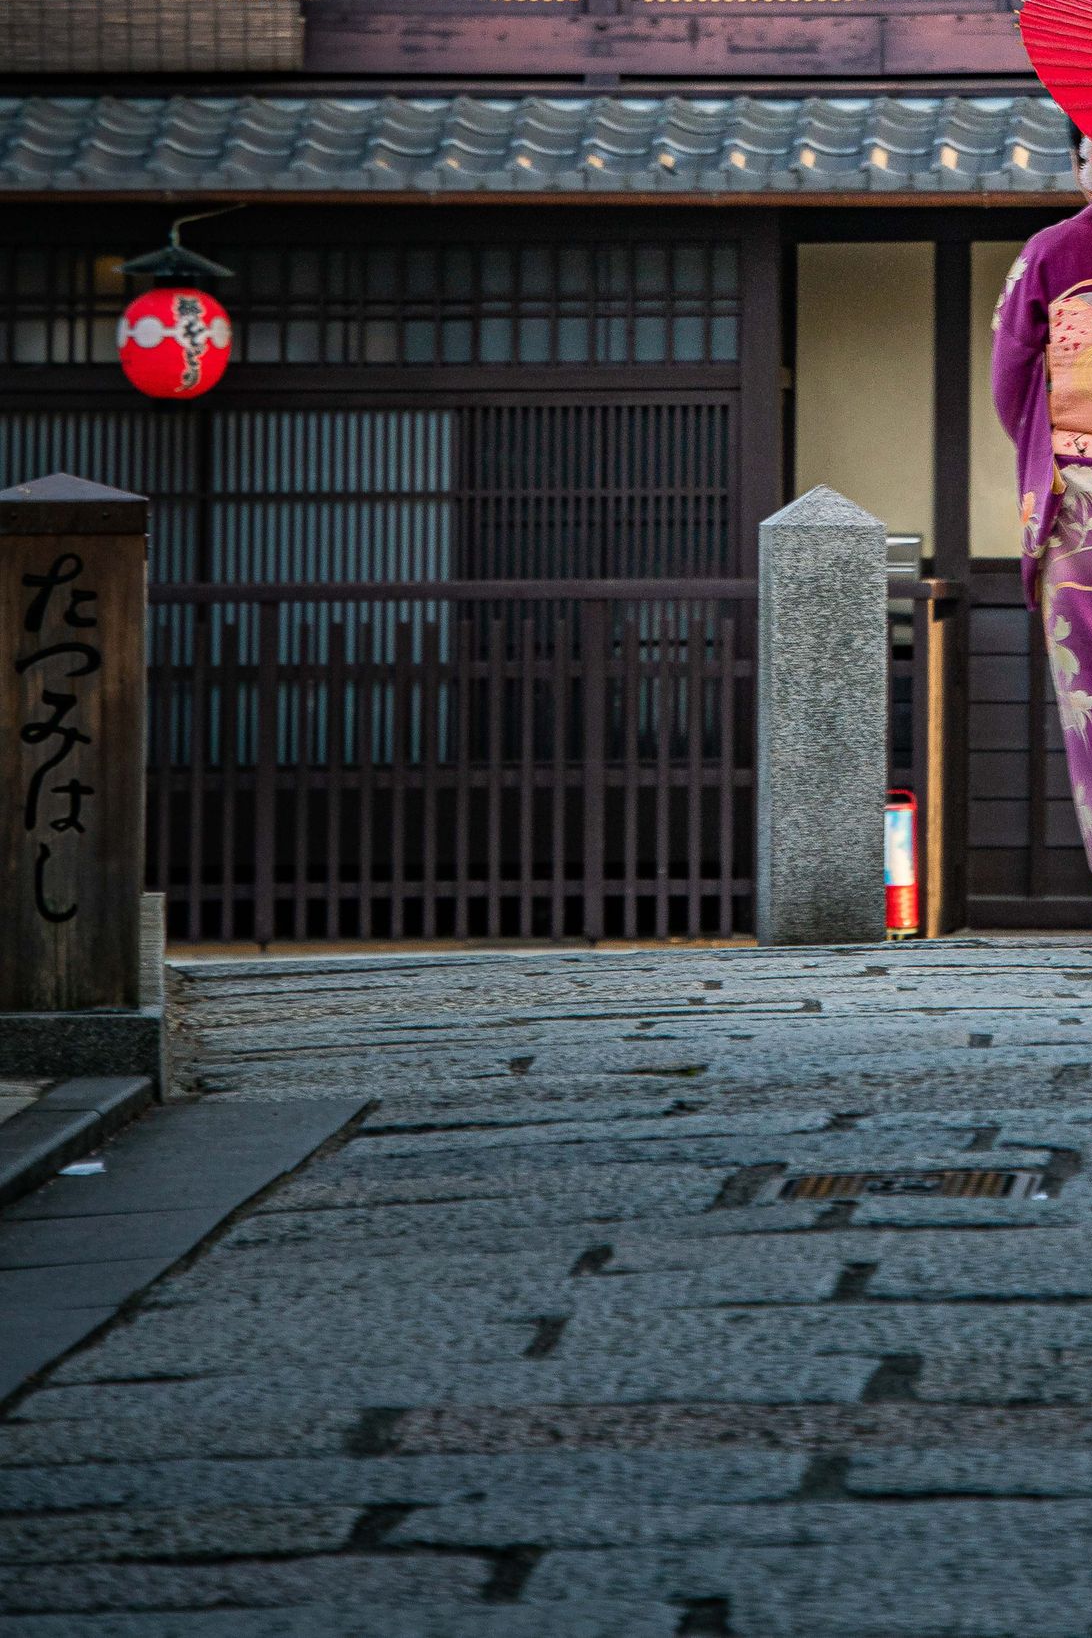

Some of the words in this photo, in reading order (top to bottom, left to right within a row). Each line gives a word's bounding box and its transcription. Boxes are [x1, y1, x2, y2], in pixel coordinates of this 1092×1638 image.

[14, 552, 102, 924] たつみはし
